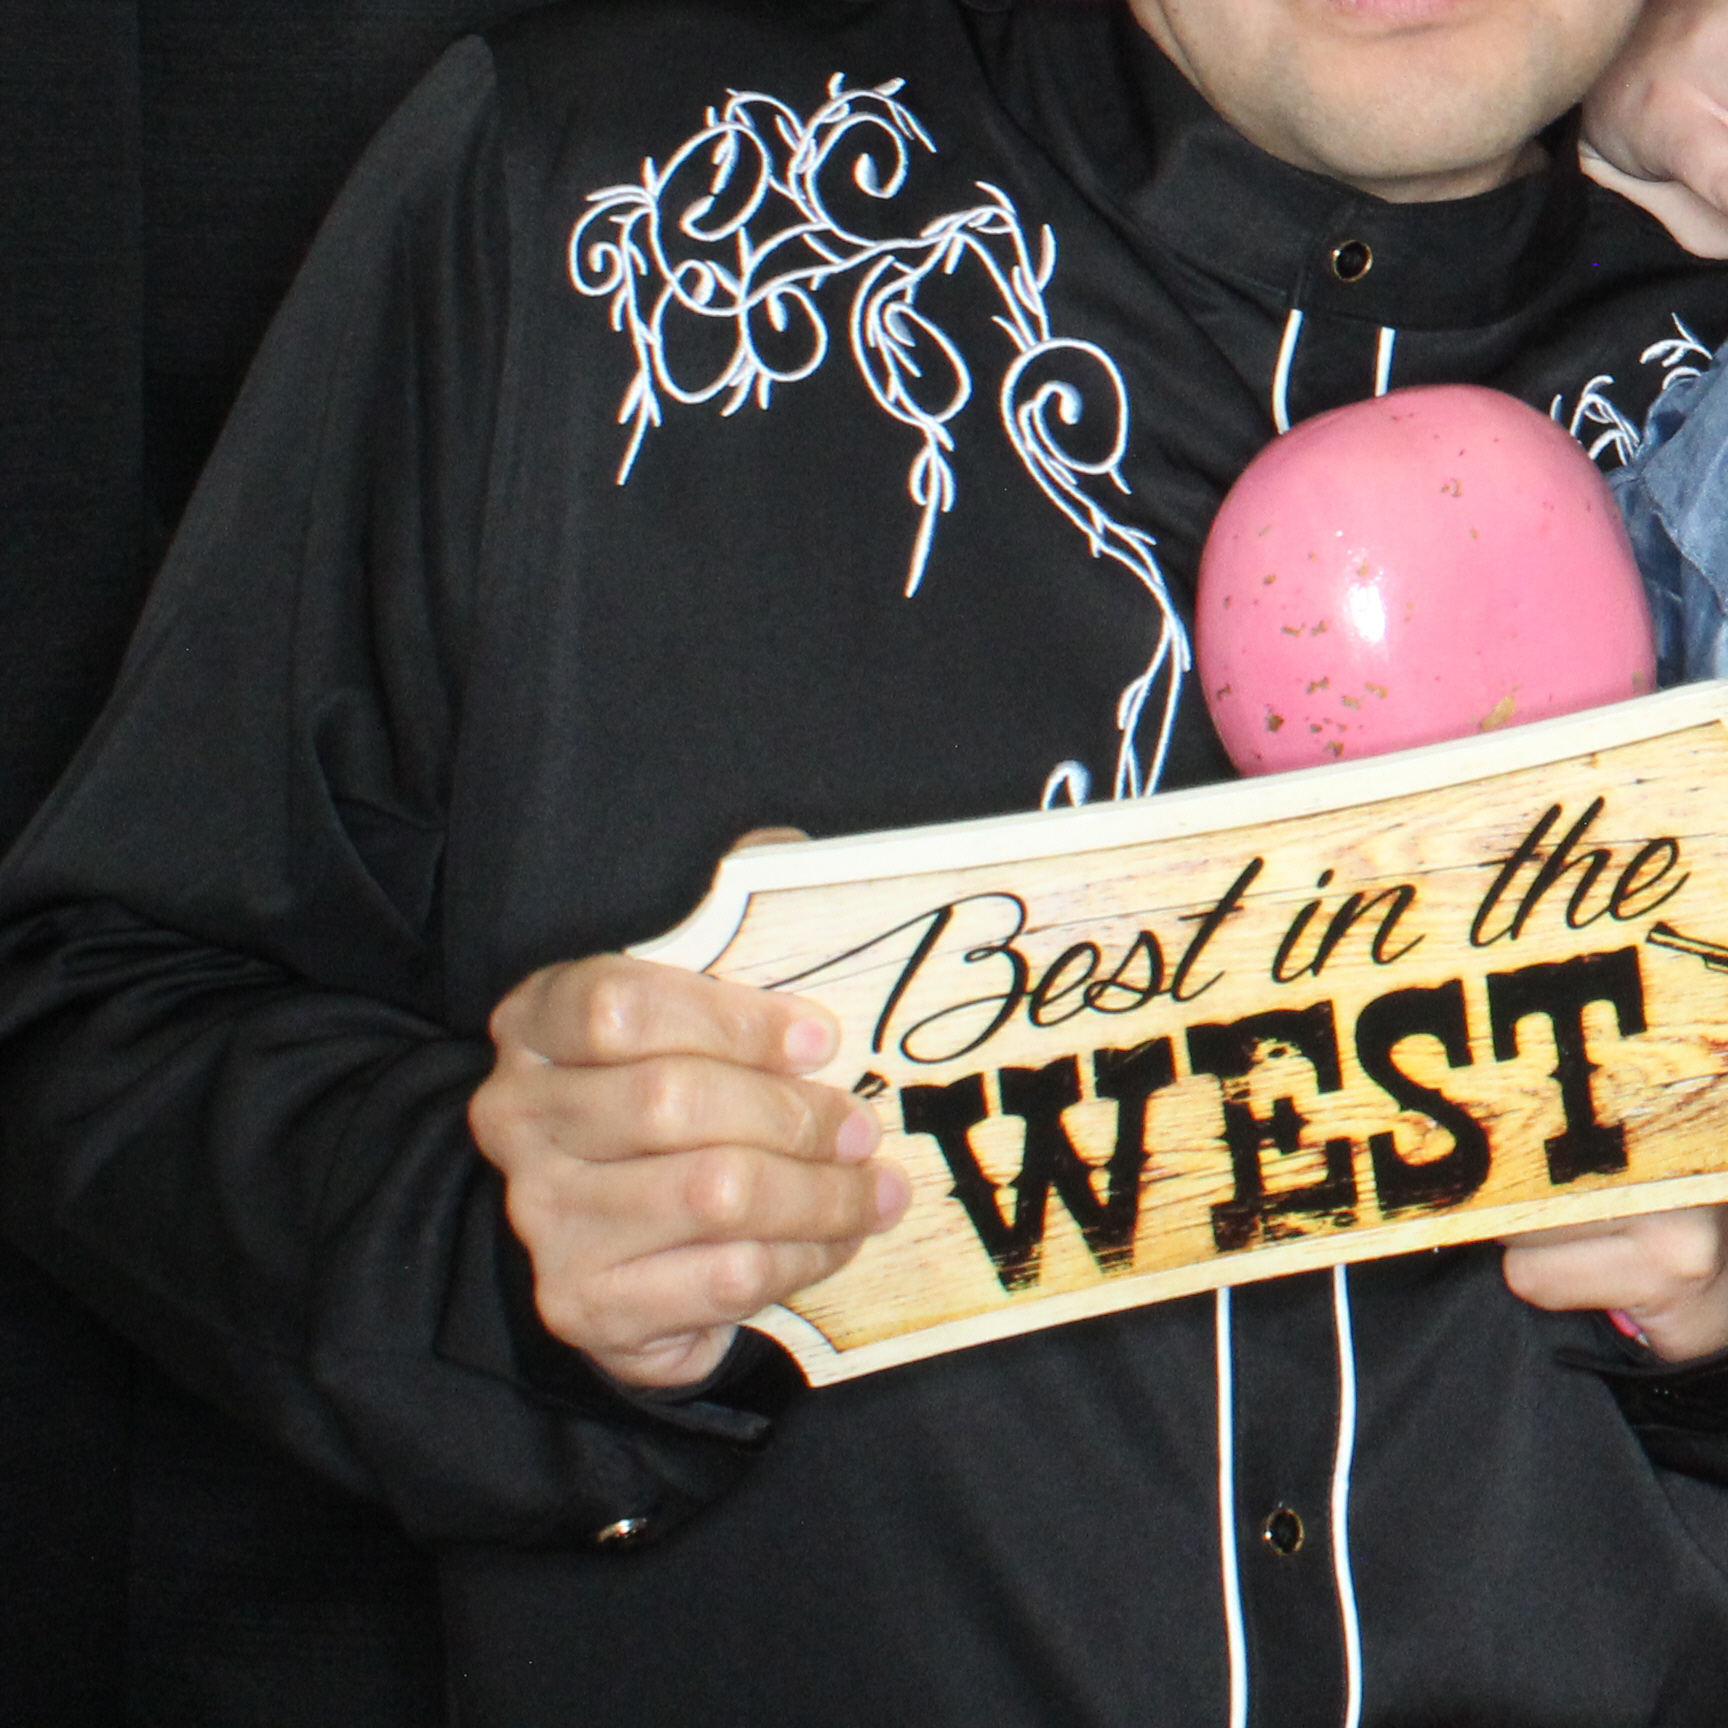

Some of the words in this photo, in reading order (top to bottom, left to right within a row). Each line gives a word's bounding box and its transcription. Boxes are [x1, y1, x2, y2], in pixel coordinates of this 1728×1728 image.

[768, 857, 1262, 1065] Best
[1272, 868, 1425, 978] in
[1468, 796, 1689, 947] the
[902, 946, 1648, 1292] WEST
